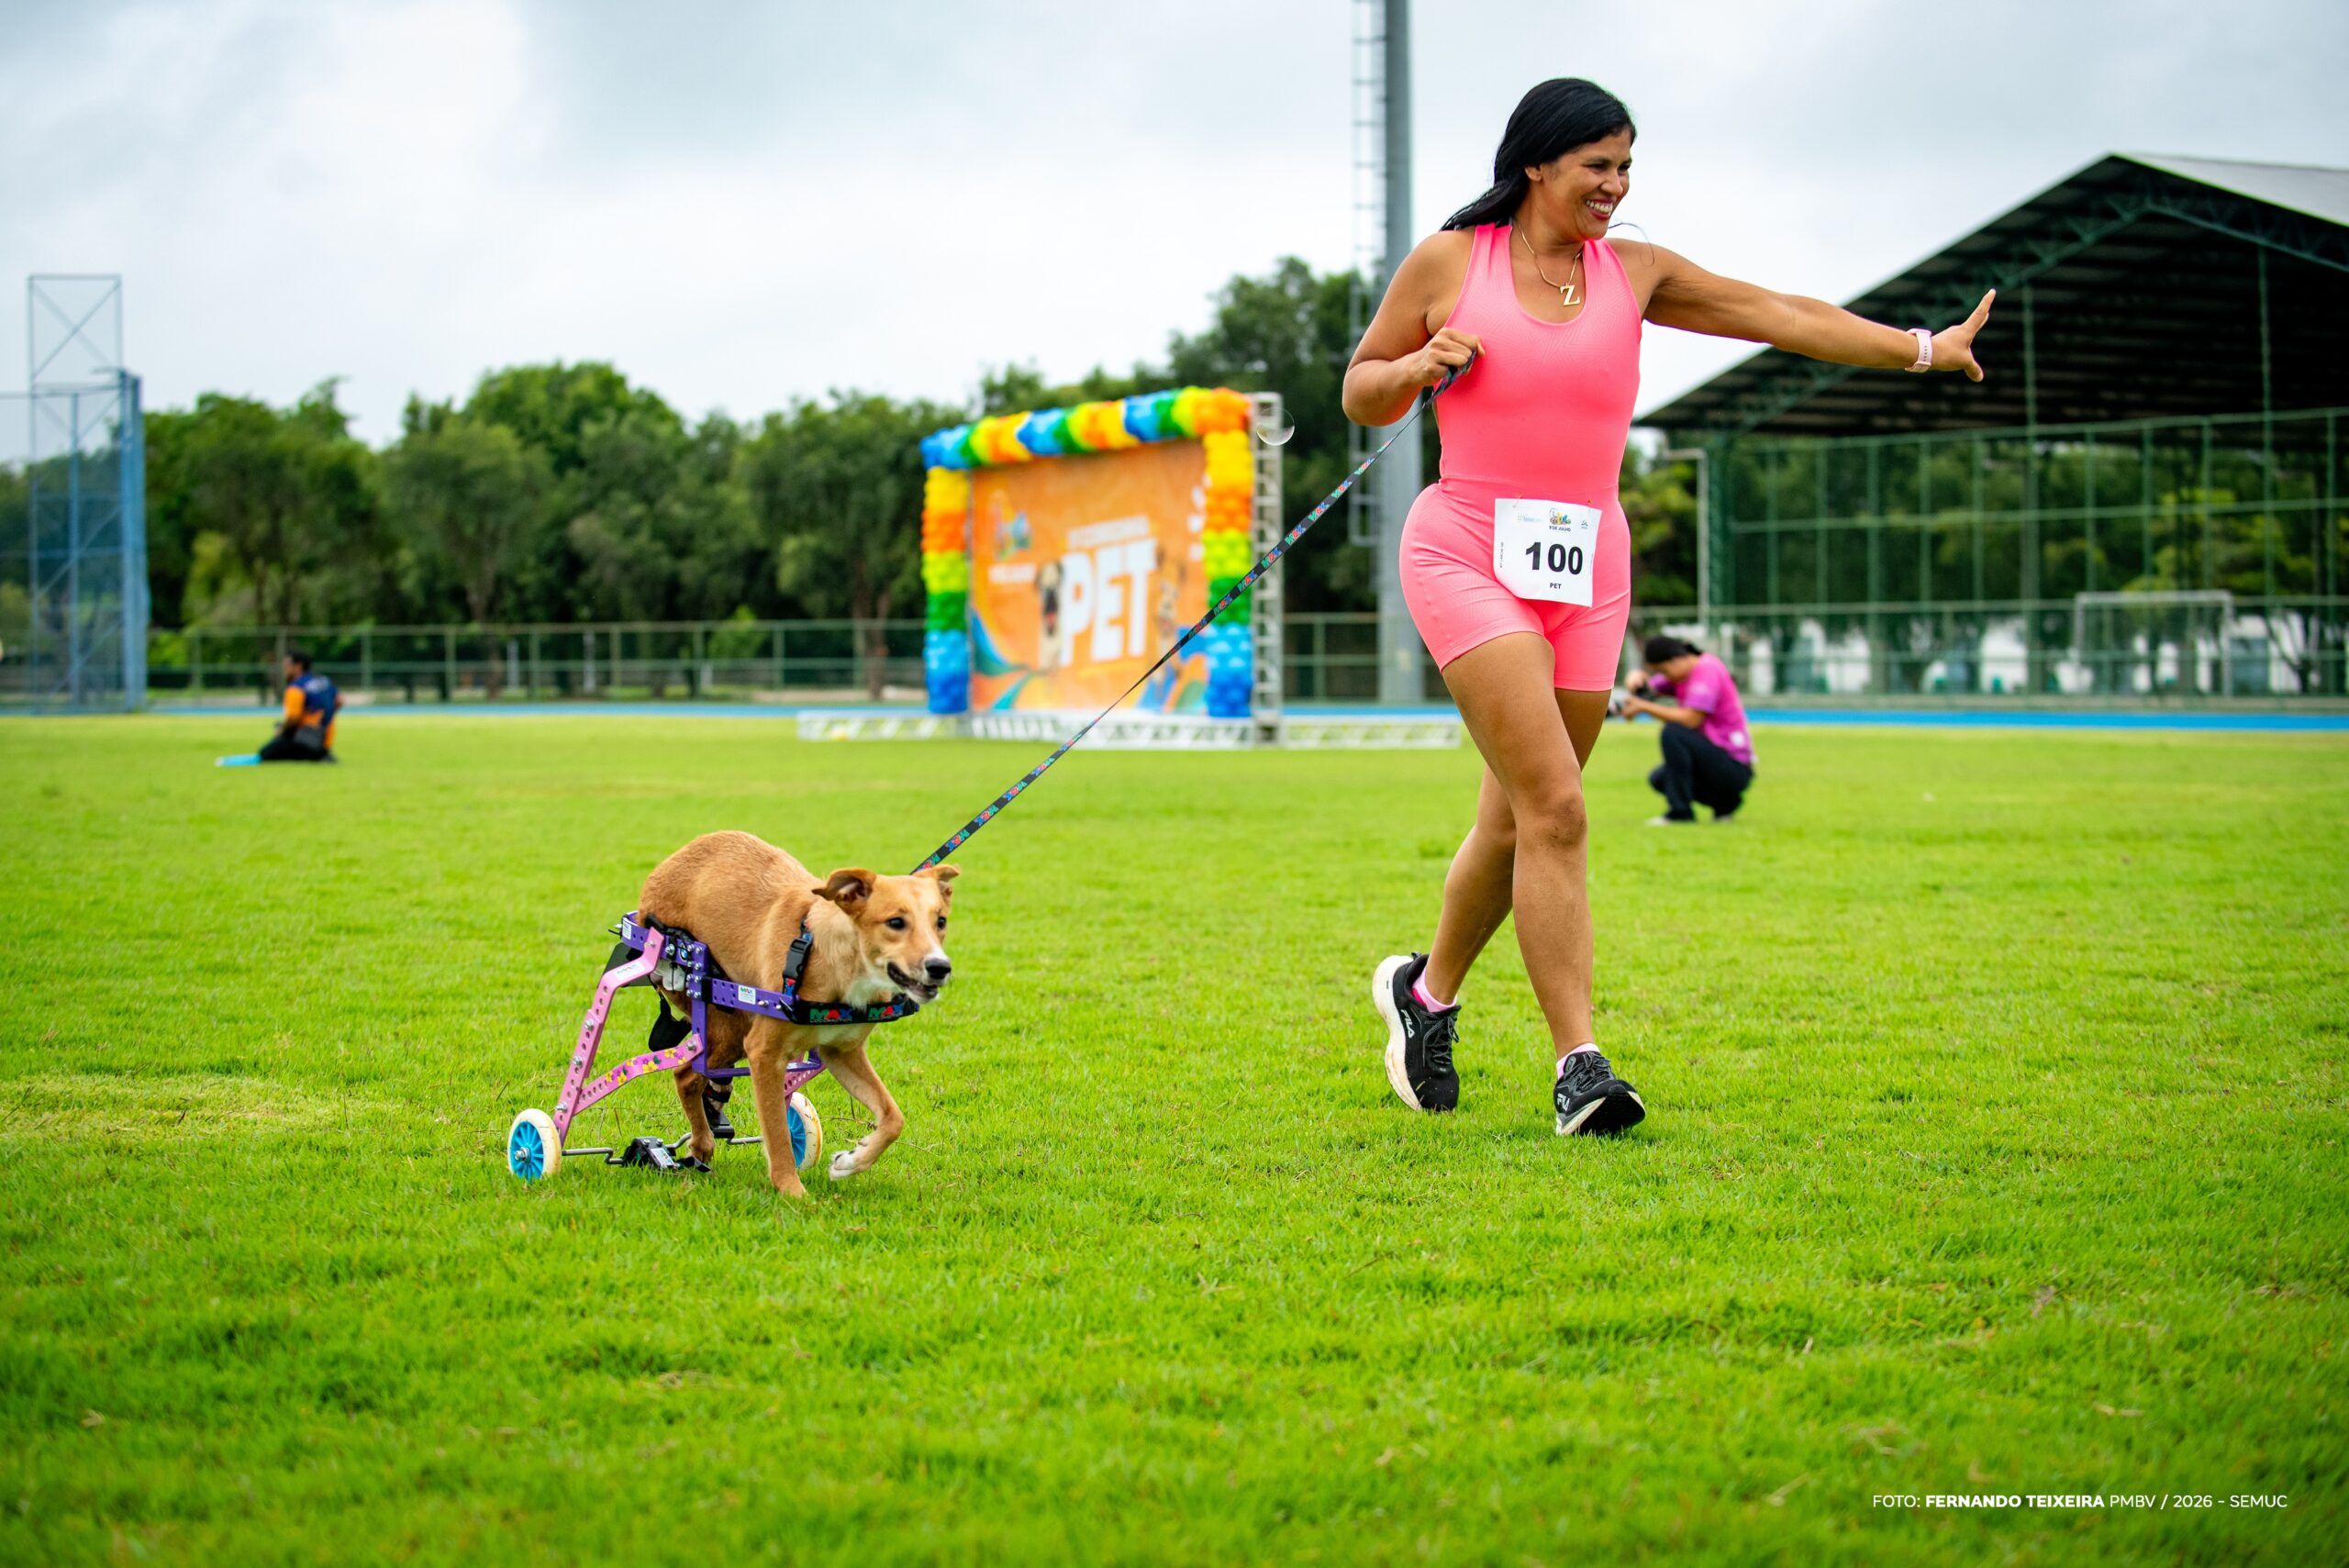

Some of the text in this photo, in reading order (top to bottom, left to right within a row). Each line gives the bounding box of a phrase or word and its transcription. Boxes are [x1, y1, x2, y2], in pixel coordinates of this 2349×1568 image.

[1560, 284, 1580, 306] Z
[1525, 541, 1584, 575] 100
[1059, 538, 1157, 667] PET
[809, 1007, 853, 1020] MAX
[867, 1003, 905, 1019] MAX
[1400, 1008, 1416, 1039] FILA
